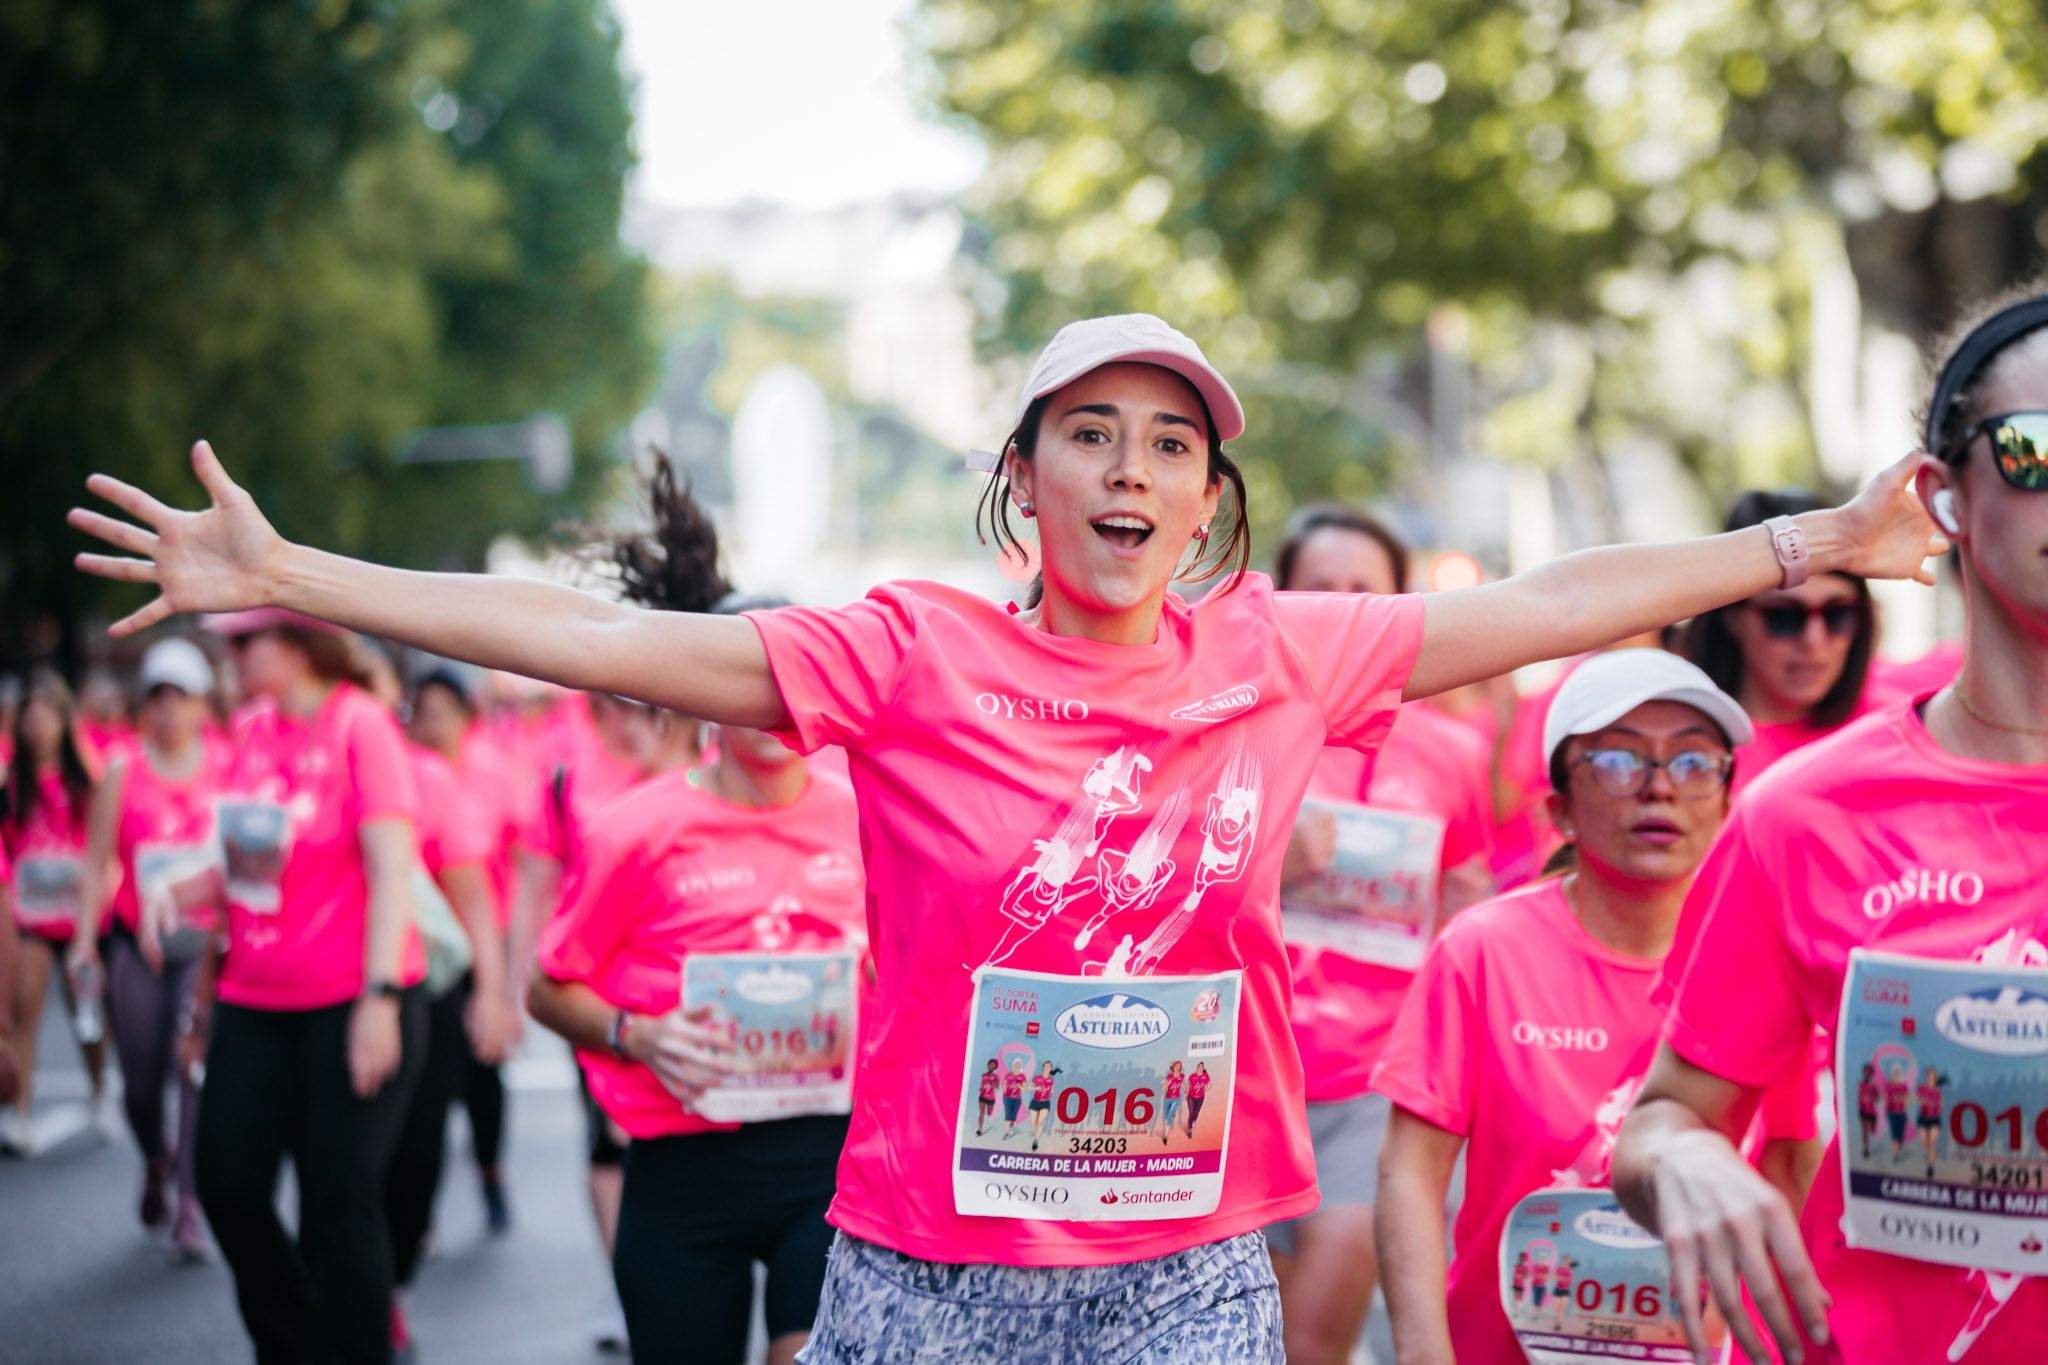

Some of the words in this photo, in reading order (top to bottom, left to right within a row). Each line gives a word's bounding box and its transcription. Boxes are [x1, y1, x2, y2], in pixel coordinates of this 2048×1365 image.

[976, 692, 1088, 721] OYSHO
[1863, 868, 1984, 919] OYSHO
[993, 996, 1038, 1014] SUMA
[1063, 1012, 1162, 1035] ASTURIANA
[1512, 1020, 1609, 1053] OYSHO
[1057, 1086, 1155, 1125] 016
[1069, 1137, 1127, 1154] 34203
[988, 1154, 1050, 1171] CARRERA
[1053, 1158, 1070, 1172] DE
[1074, 1159, 1090, 1173] LA
[1094, 1159, 1137, 1173] MUJER
[1147, 1156, 1195, 1172] MADRID
[985, 1182, 1069, 1205] OYSHO
[1121, 1188, 1195, 1204] Santander
[1880, 1212, 1980, 1247] OYSHO
[1575, 1279, 1662, 1317] 016
